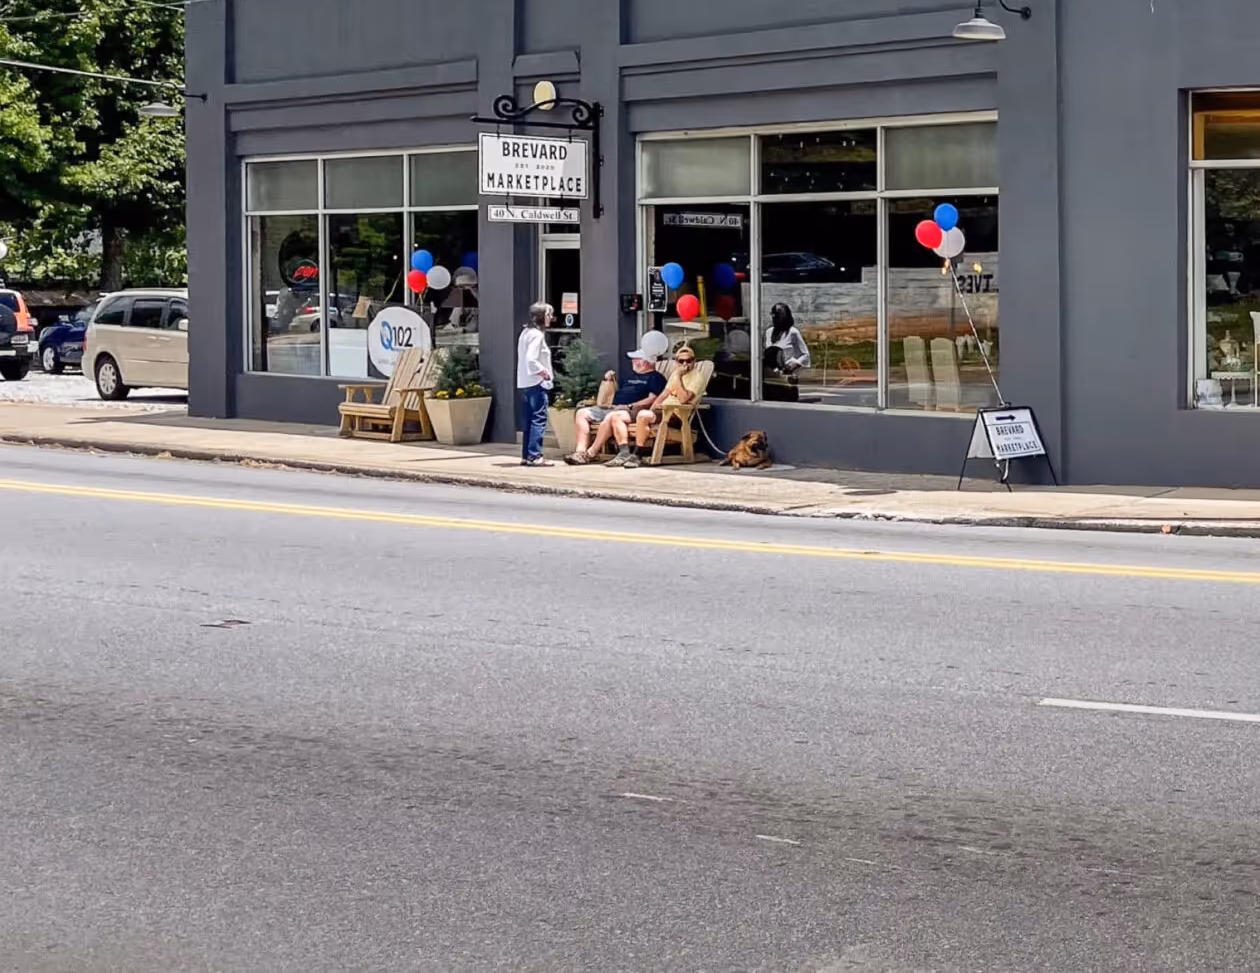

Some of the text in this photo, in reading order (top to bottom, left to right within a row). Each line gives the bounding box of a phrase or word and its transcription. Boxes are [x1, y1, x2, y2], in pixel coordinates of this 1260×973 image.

[502, 141, 567, 160] BREVARD
[487, 172, 582, 192] MARKETPLACE
[493, 209, 505, 218] 40
[521, 209, 561, 219] Caldwell
[380, 321, 413, 350] Q102
[996, 425, 1024, 436] BREVARD
[996, 441, 1038, 453] MARKETPLACE
